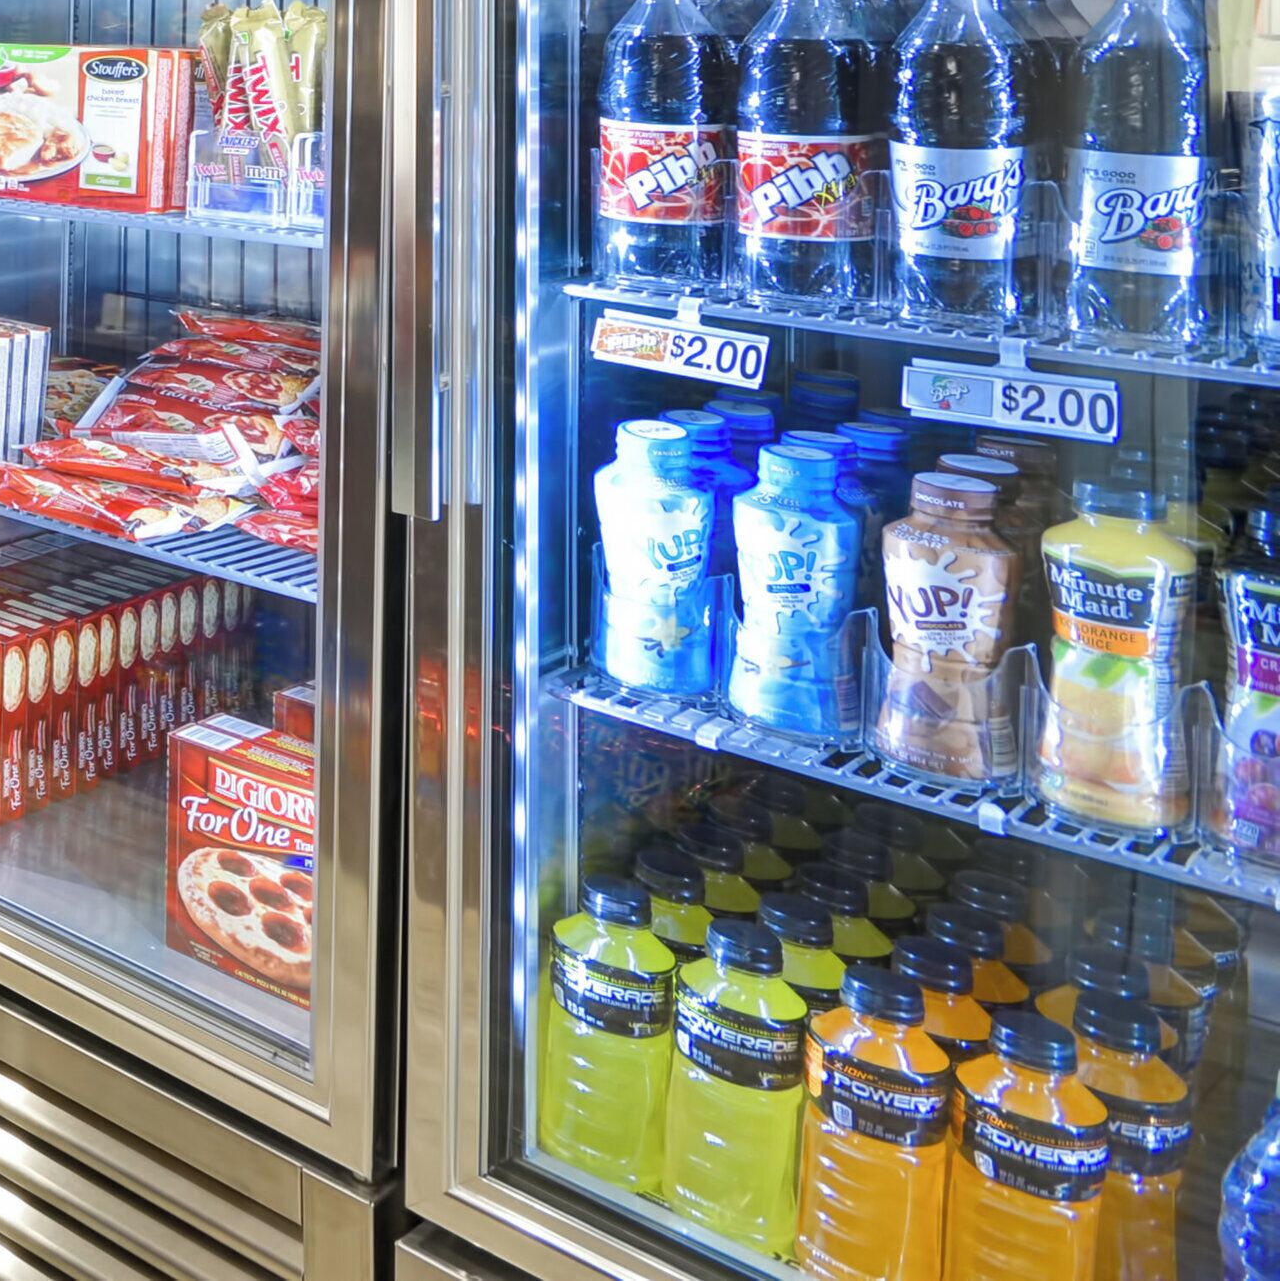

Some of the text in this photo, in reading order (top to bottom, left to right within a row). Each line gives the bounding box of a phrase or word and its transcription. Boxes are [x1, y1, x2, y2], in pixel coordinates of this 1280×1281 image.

[89, 61, 140, 78] Stouffer's
[623, 139, 718, 211] Pibb
[750, 151, 852, 225] Pibb
[670, 334, 762, 380] $2.00
[1001, 383, 1116, 435] $2.00
[915, 492, 965, 509] CHOCOLATE
[888, 584, 974, 624] YUP!
[1050, 562, 1144, 603] Minute
[1060, 586, 1130, 620] Maid
[1081, 624, 1137, 644] ORANGE
[215, 766, 315, 826] DIGIORN
[181, 795, 291, 847] For One
